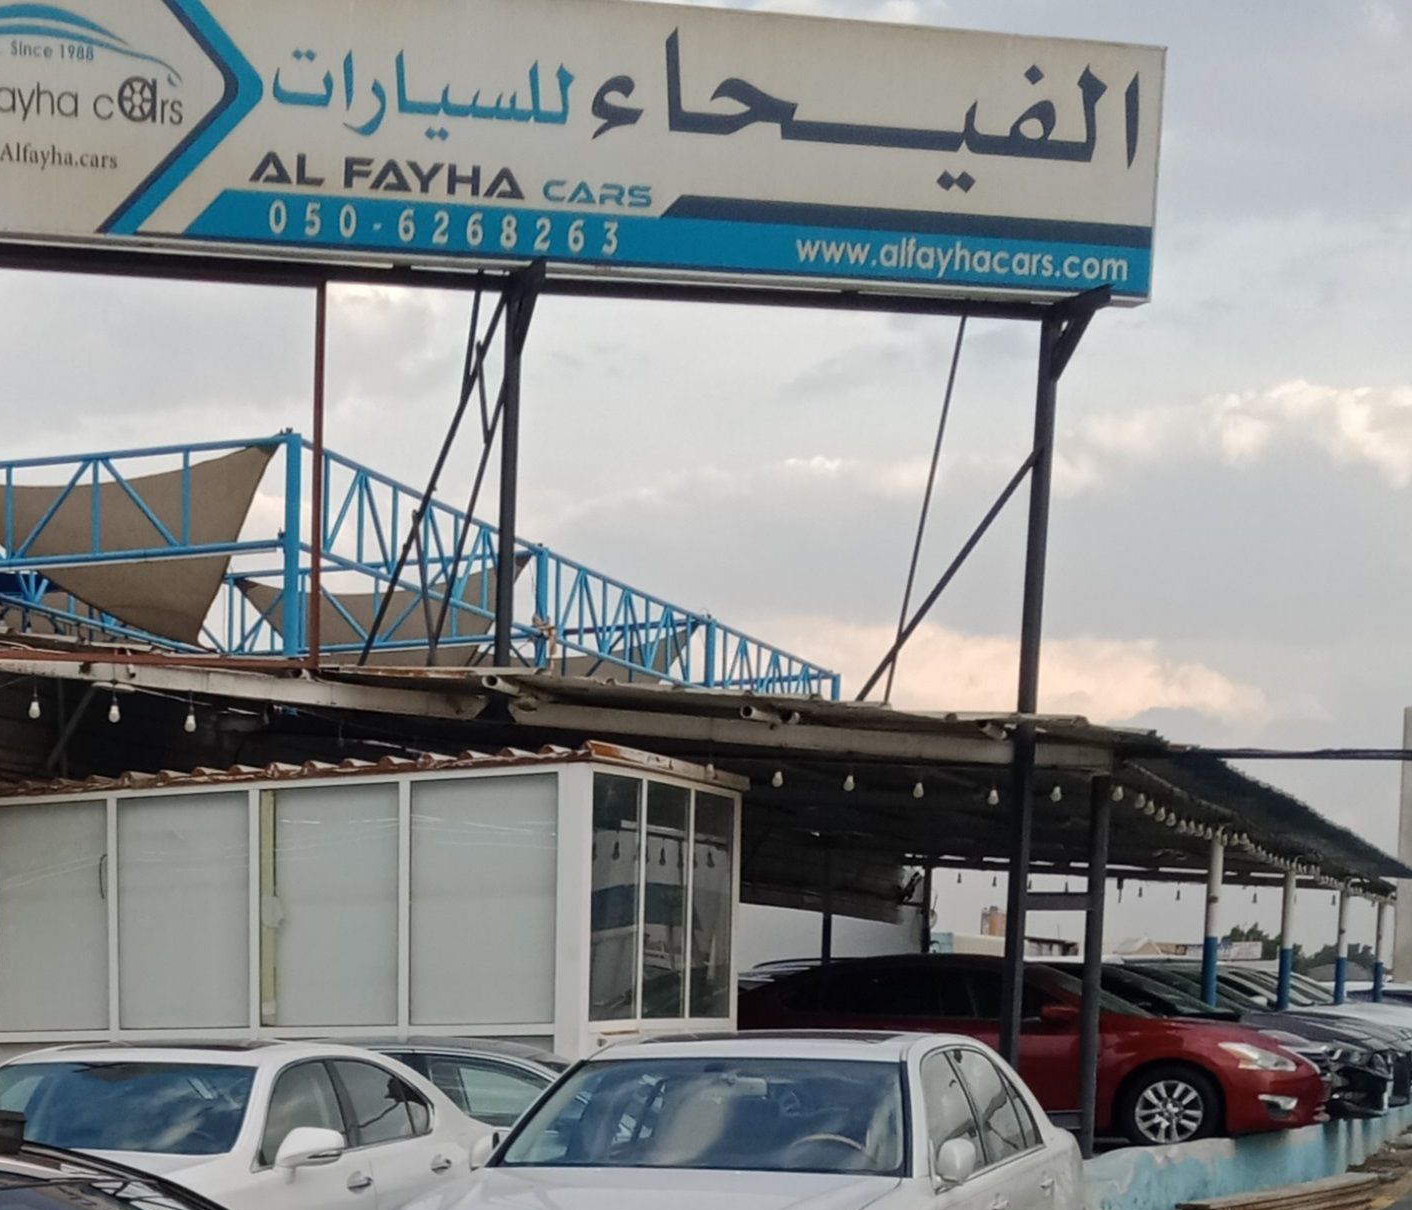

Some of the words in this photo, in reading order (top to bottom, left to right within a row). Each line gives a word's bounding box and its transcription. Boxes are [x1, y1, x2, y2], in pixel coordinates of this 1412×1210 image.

[60, 43, 95, 62] 1988
[93, 75, 184, 126] cars
[272, 47, 576, 141] للسيارات
[591, 26, 1141, 194] الفيحاء
[0, 142, 118, 171] Alfayha.cars
[248, 150, 326, 188] AL
[343, 155, 526, 201] FAYHA
[541, 178, 653, 209] CARS
[268, 198, 621, 257] 050-6268263
[795, 236, 1130, 282] www.alfayhacars.com
